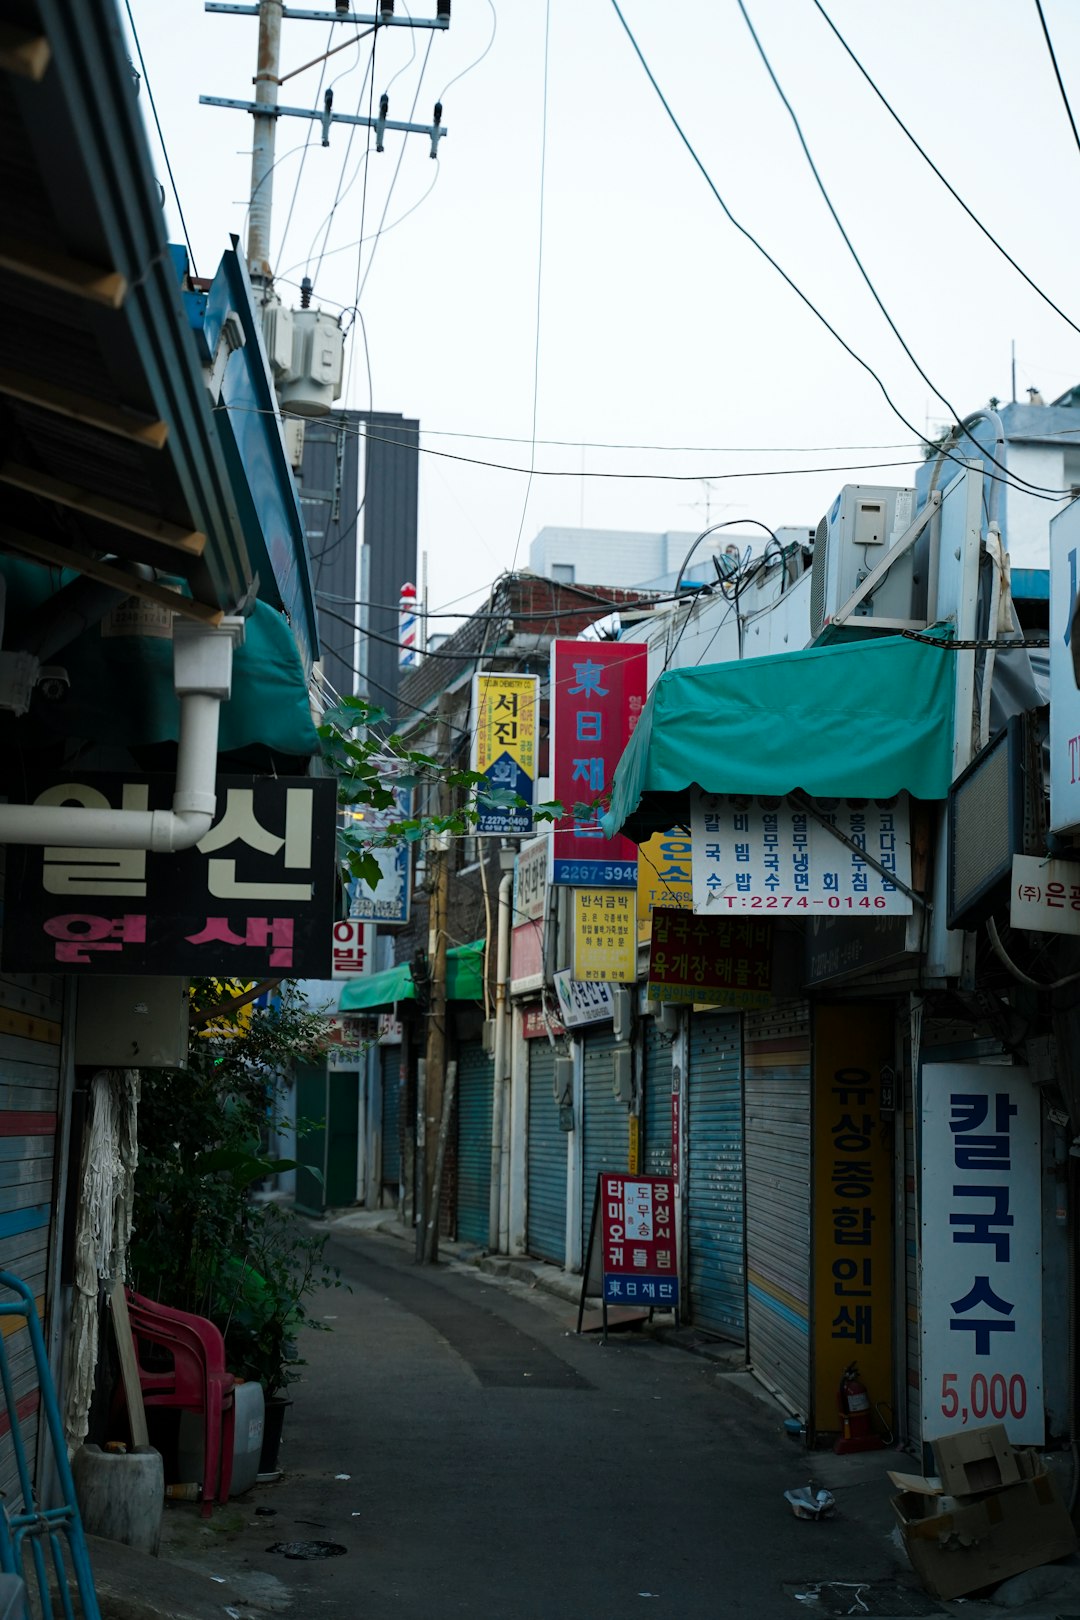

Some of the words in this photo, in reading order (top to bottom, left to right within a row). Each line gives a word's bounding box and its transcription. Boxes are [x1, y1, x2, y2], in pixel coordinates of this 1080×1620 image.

[490, 692, 520, 816] 서진화
[704, 813, 721, 890] 칼국수
[733, 813, 752, 891] 비빔밥
[762, 813, 780, 891] 열무국수
[791, 813, 809, 892] 열무냉면
[850, 813, 867, 892] 홍어무침
[581, 895, 629, 909] 반석금박
[723, 896, 886, 908] T:2274-0146
[333, 922, 367, 971] 이발
[637, 1187, 651, 1237] 도무송
[949, 1093, 1018, 1356] 칼국수
[608, 1279, 673, 1298] 東日재단
[941, 1373, 1027, 1425] 5,000
